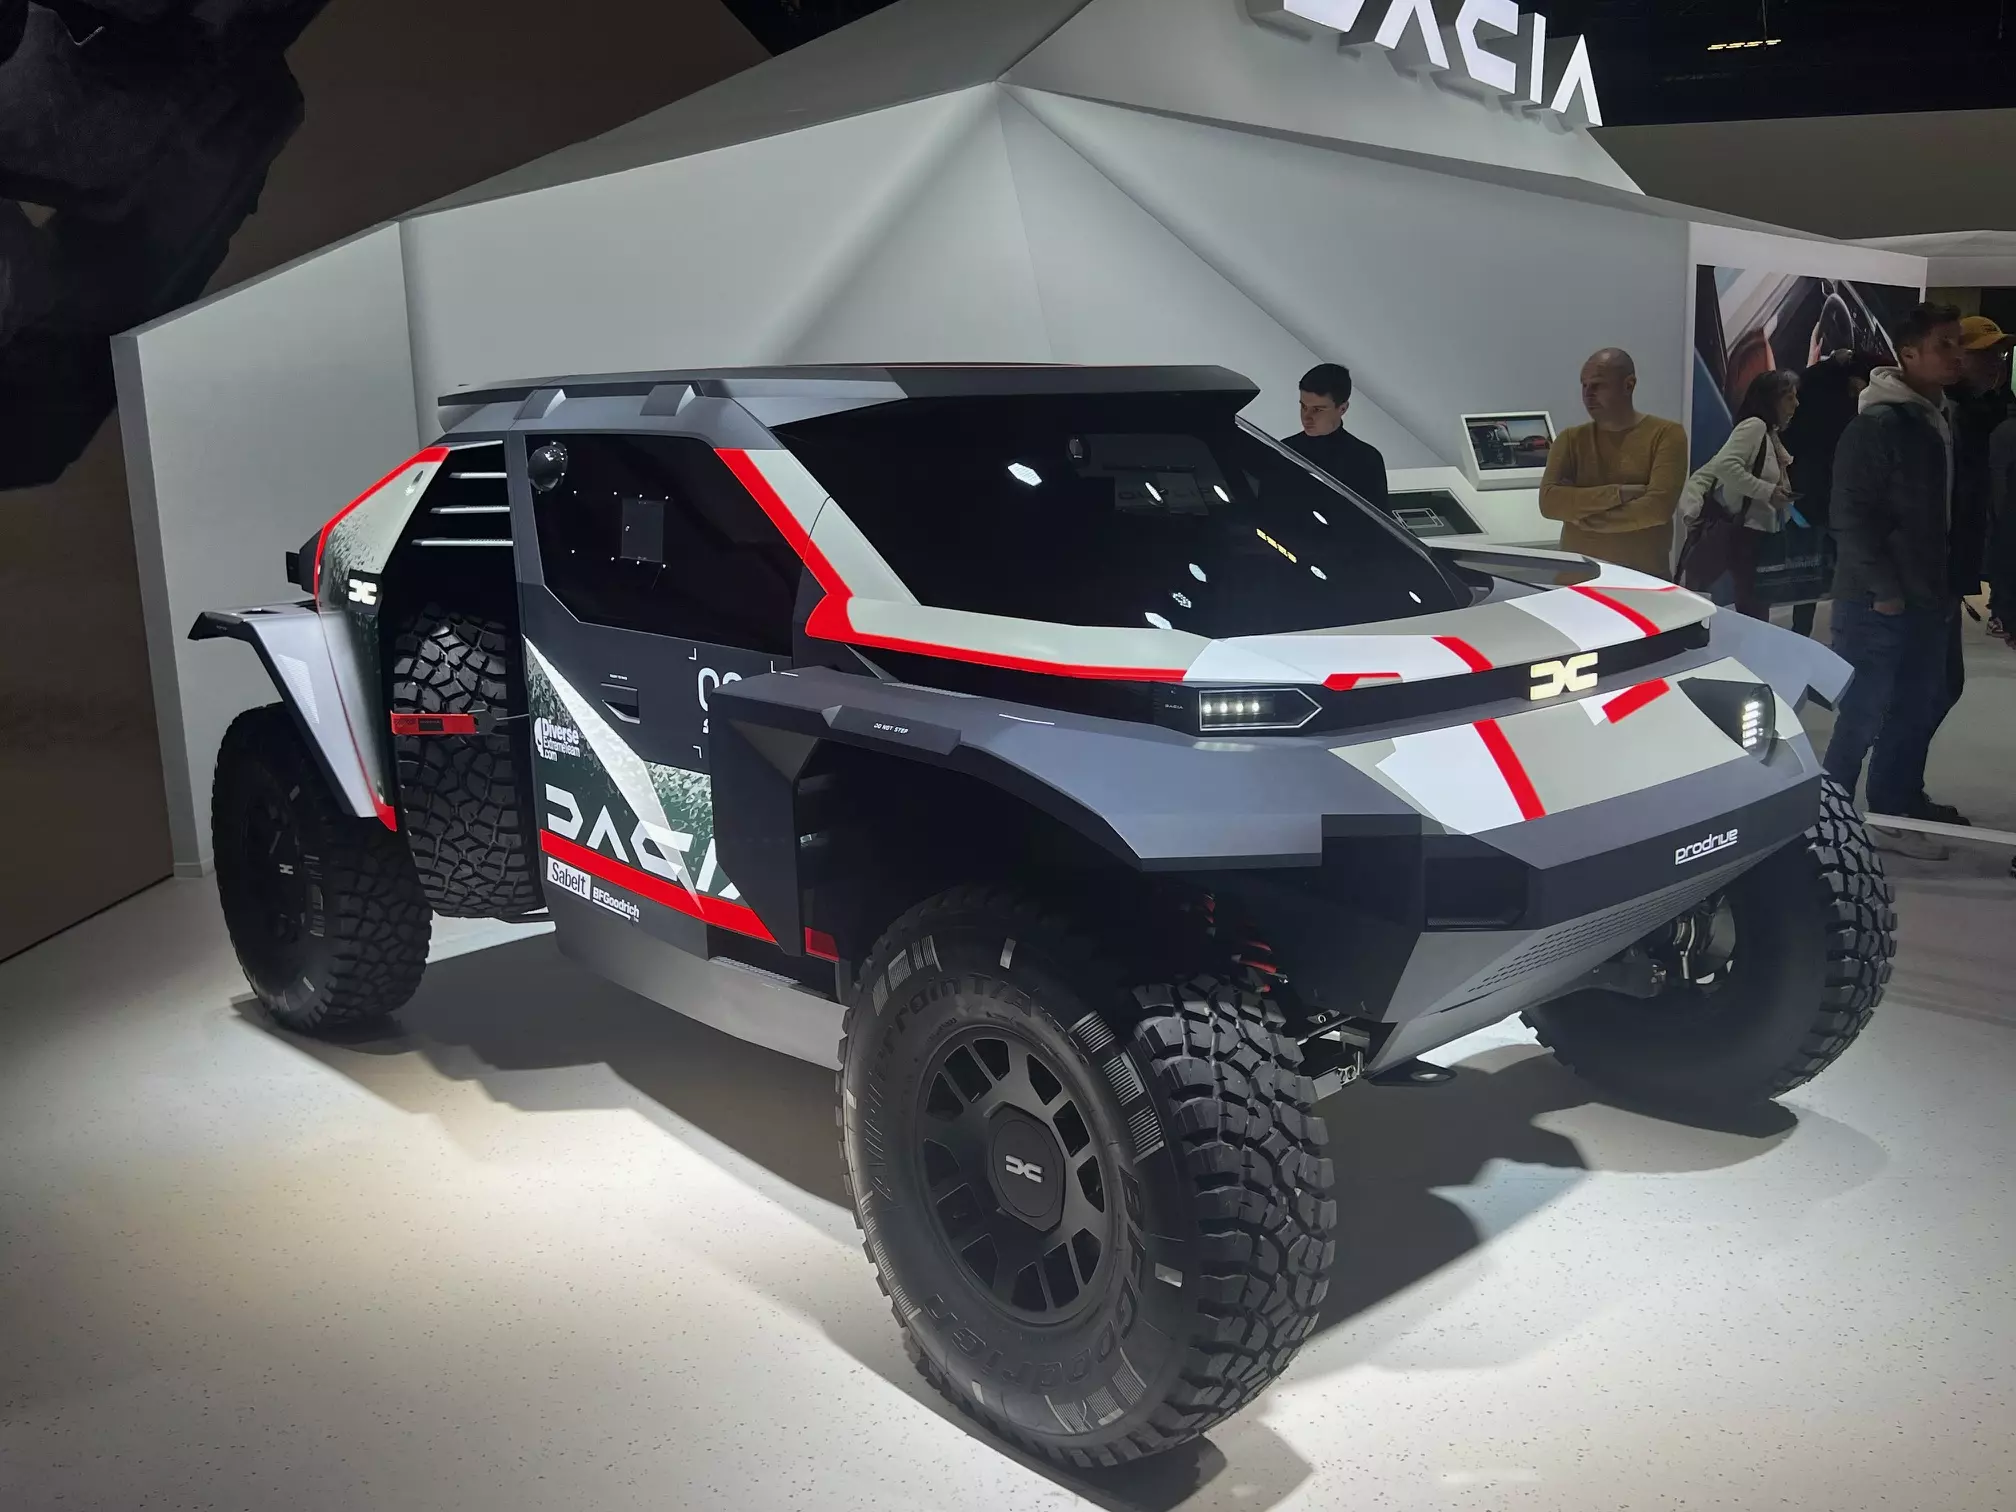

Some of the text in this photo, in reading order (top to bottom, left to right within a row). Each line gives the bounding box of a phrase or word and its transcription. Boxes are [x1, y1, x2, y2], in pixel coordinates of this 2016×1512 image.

[542, 718, 579, 745] Diverse
[894, 726, 909, 734] STEP
[545, 783, 741, 900] DACI
[1675, 829, 1738, 865] prodrive
[552, 861, 586, 895] Sabelt
[592, 886, 640, 918] BFGoodrich
